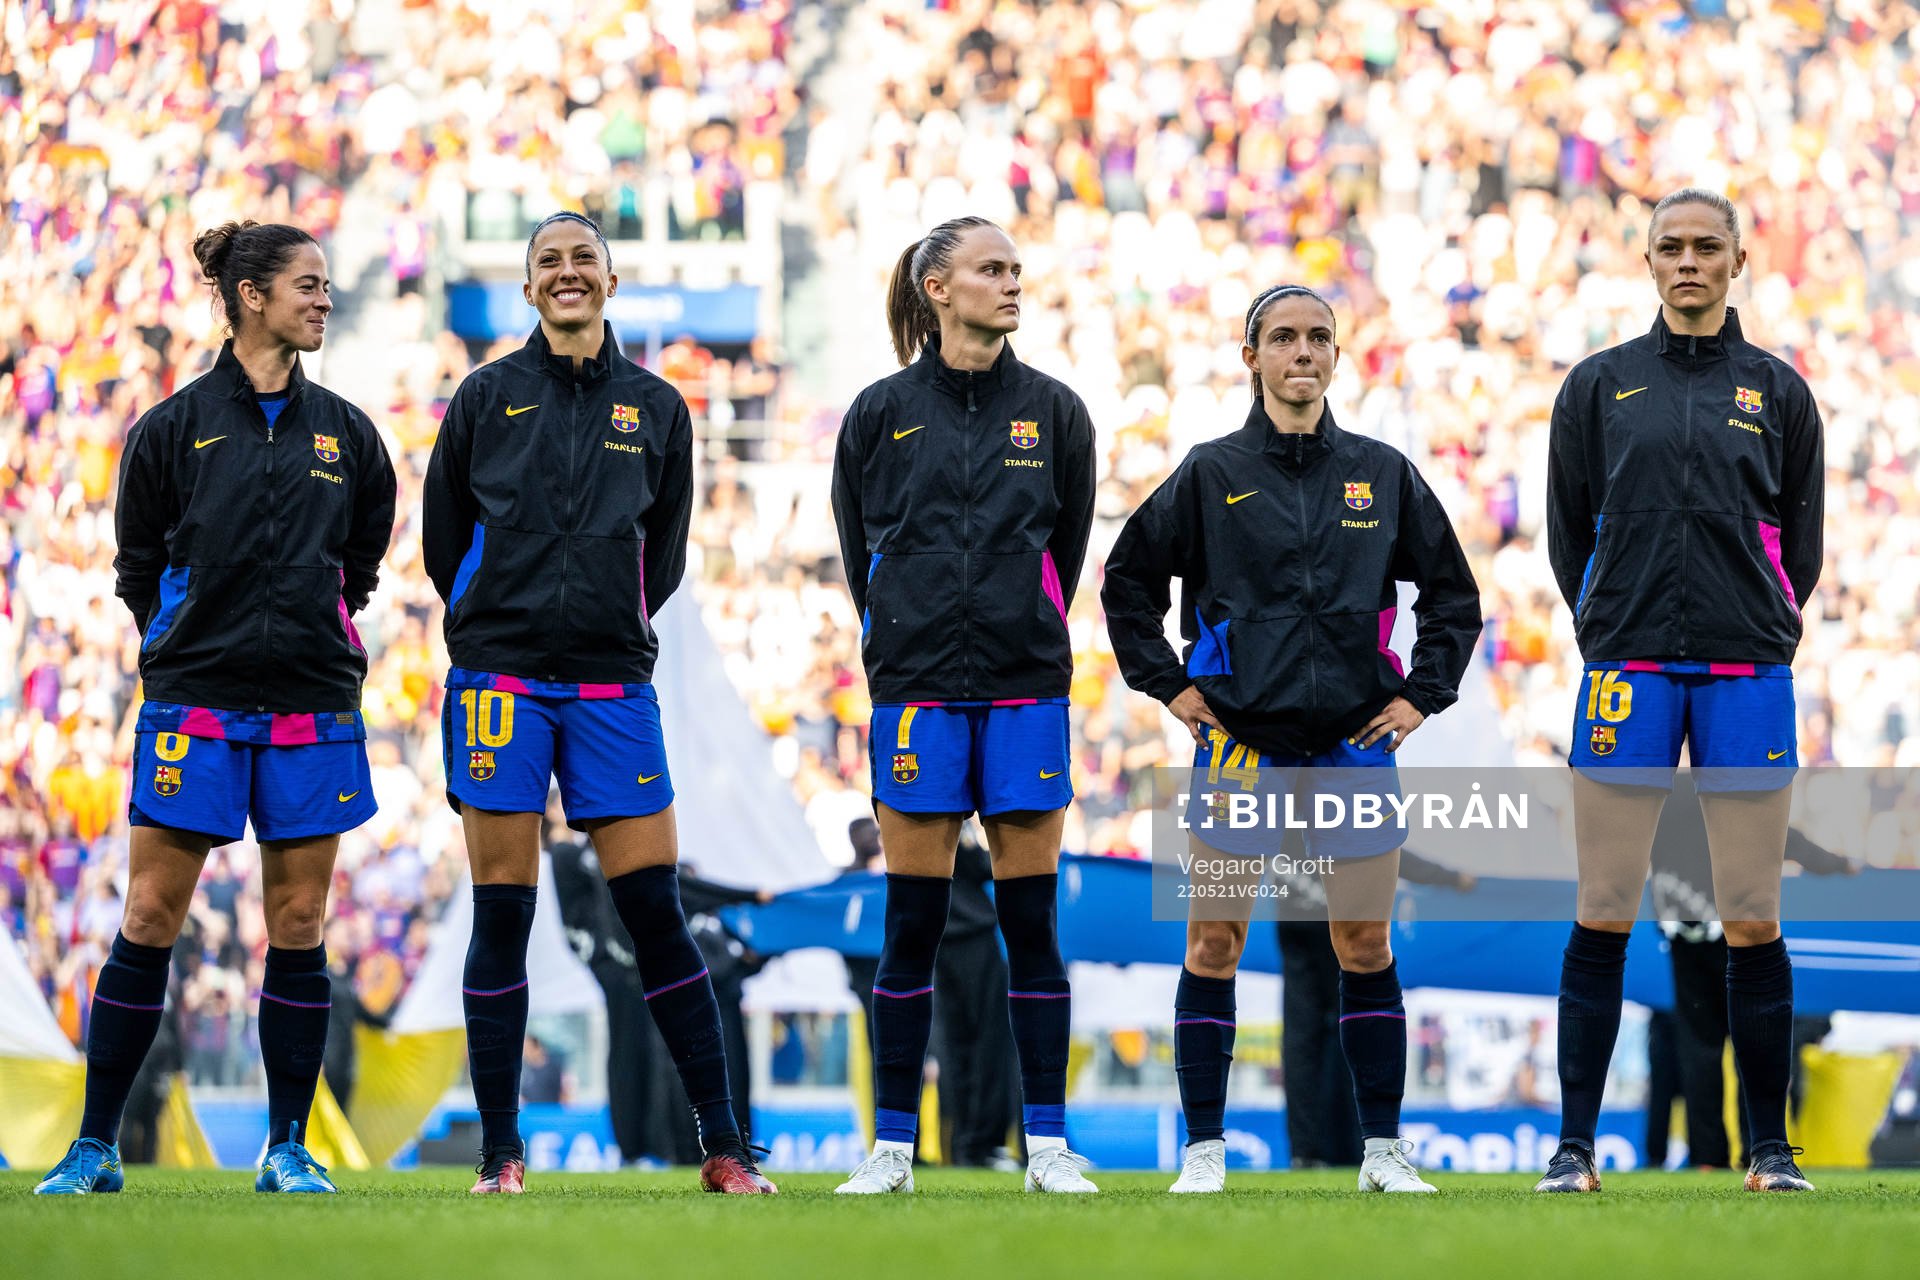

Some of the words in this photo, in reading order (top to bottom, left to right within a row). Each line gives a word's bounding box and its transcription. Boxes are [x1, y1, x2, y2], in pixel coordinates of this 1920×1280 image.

[1727, 418, 1763, 436] STANLEY
[604, 441, 643, 454] STANLEY
[1004, 458, 1044, 468] STANLEY
[310, 469, 344, 485] STANLEY
[1341, 519, 1380, 529] STANLEY
[1586, 670, 1633, 723] 16
[459, 688, 515, 748] 10
[1206, 728, 1260, 792] 14
